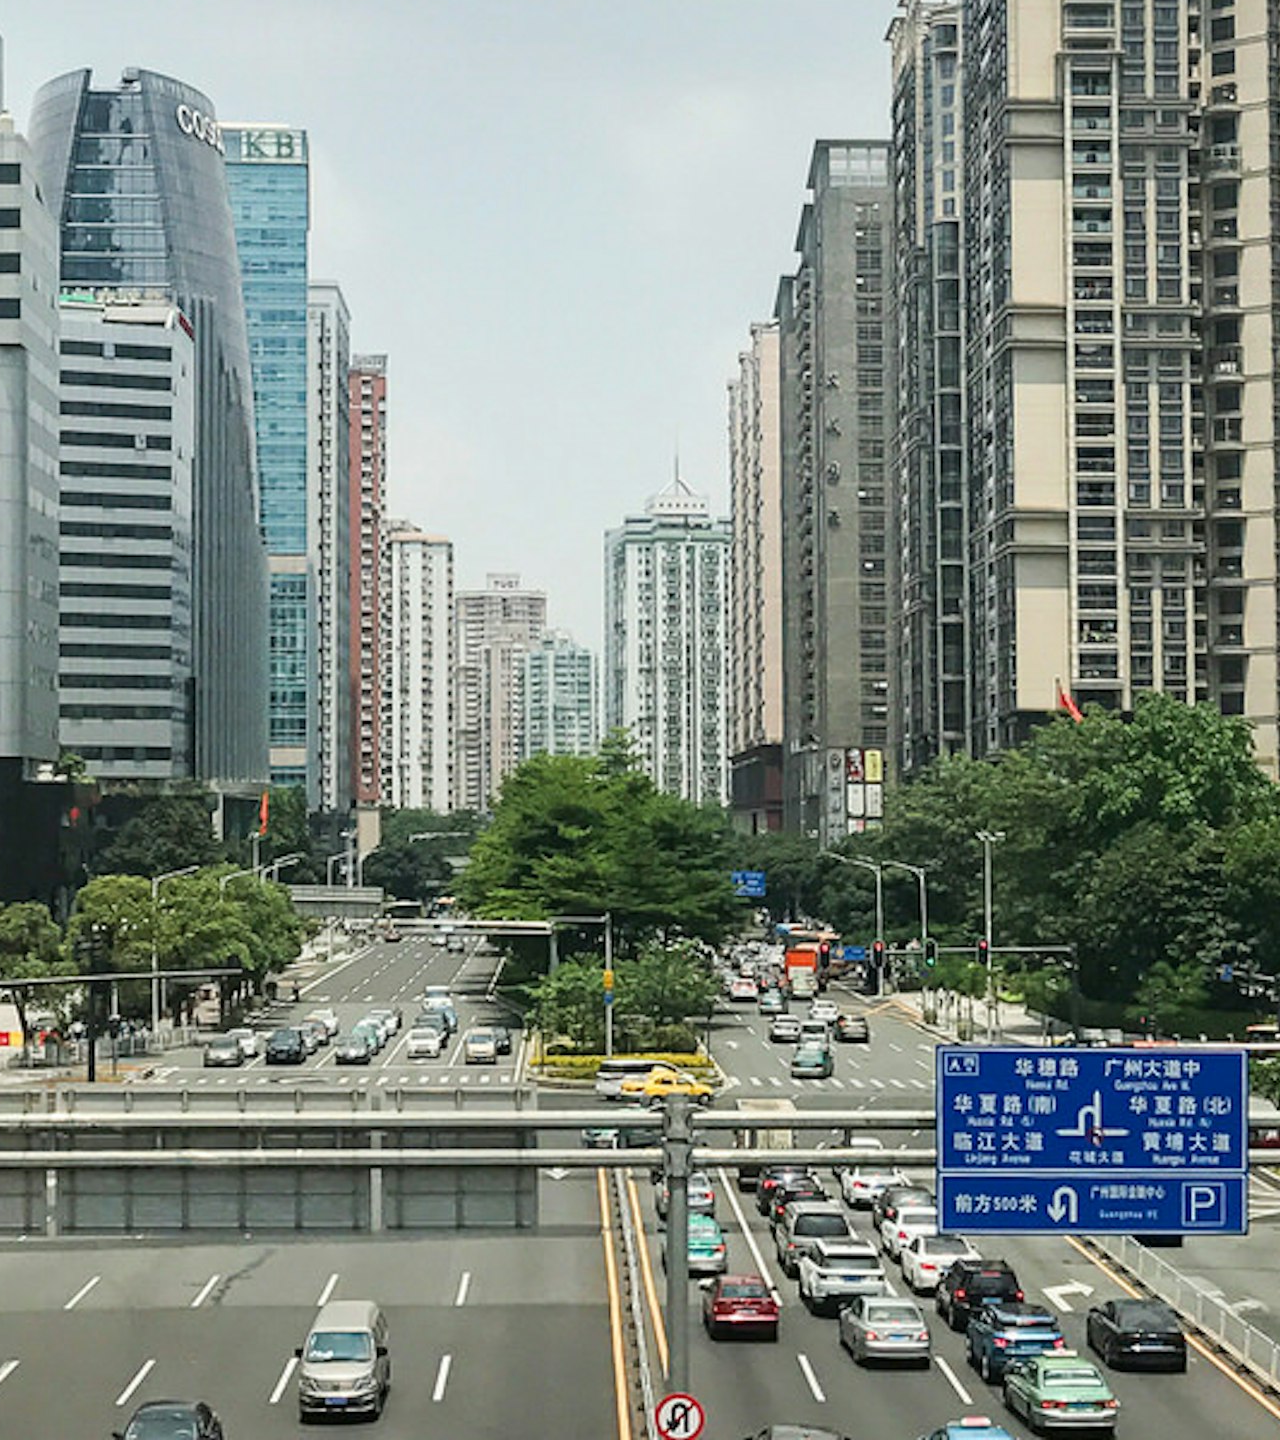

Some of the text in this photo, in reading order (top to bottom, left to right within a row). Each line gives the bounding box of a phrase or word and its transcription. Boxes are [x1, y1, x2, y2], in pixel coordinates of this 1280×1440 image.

[246, 130, 295, 158] KB
[1104, 1058, 1200, 1078] 广州大道中
[952, 1131, 1043, 1151] 临江大道
[1143, 1131, 1230, 1152] 黄埔大道
[954, 1194, 1037, 1213] 前方500米
